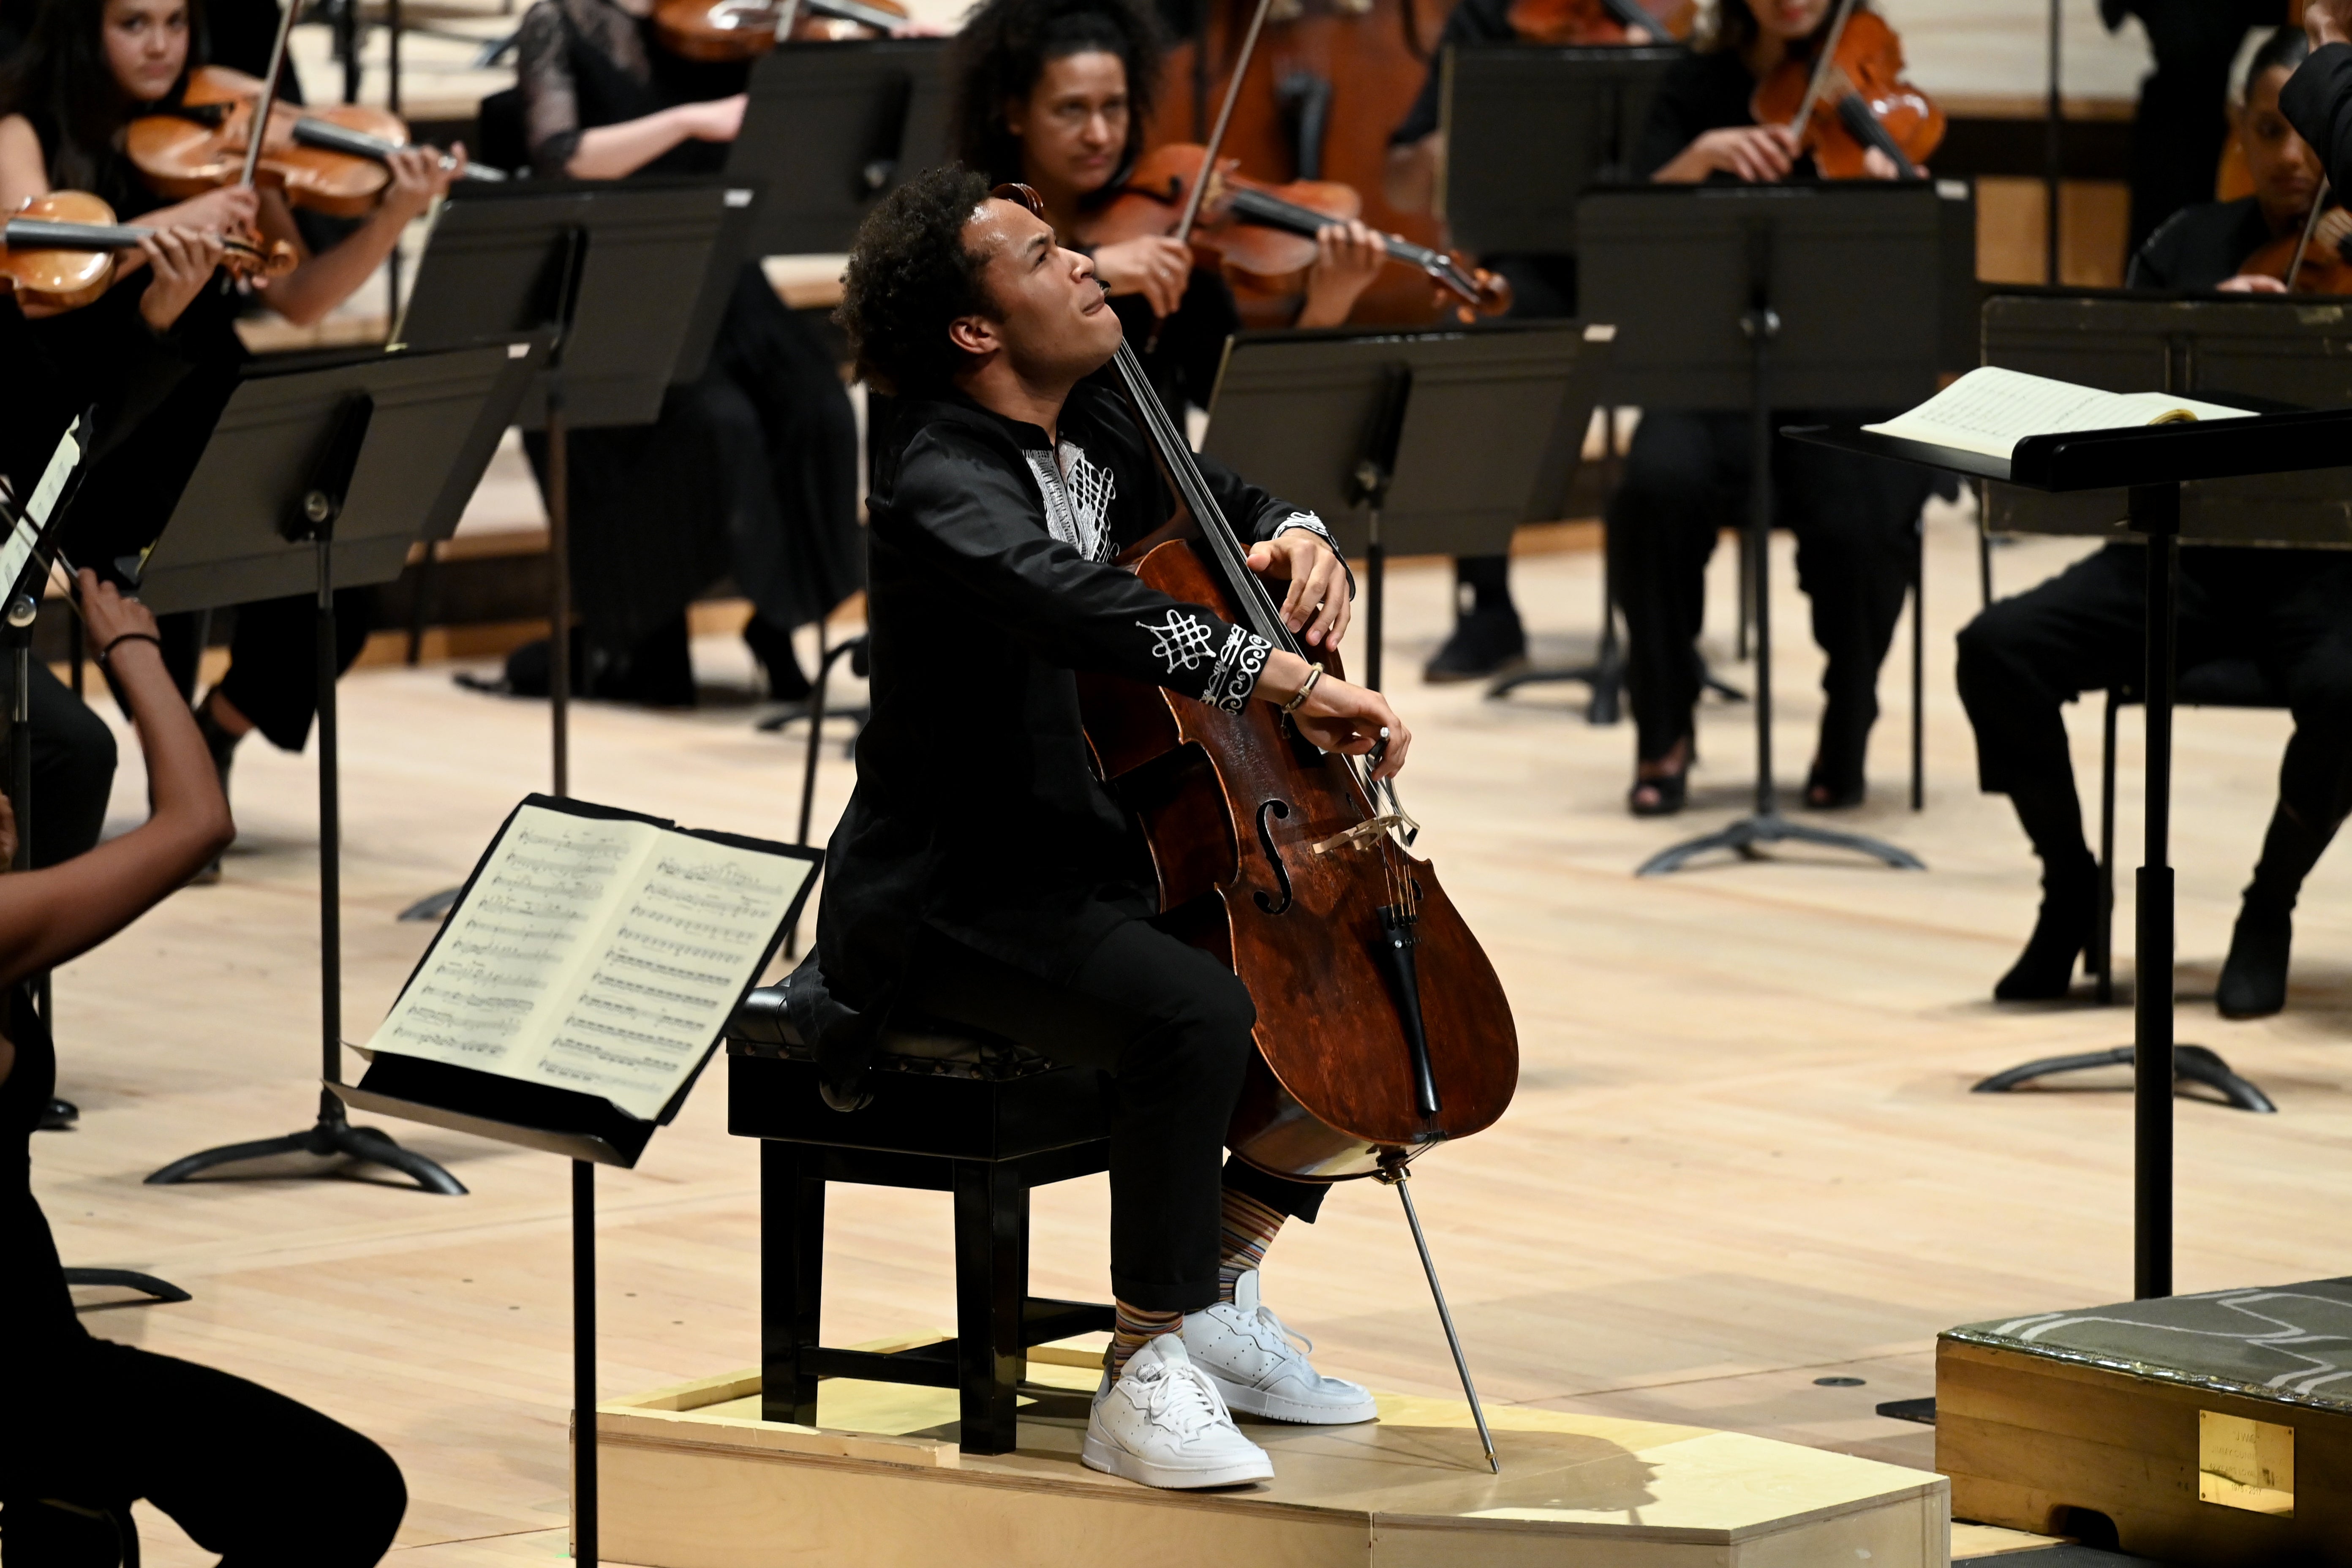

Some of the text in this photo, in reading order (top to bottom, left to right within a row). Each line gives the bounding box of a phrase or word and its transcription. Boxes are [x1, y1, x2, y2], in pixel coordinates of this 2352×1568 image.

[2212, 1446, 2233, 1456] JIMMY
[2231, 1484, 2244, 1492] 1975
[2249, 1486, 2262, 1495] 2017
